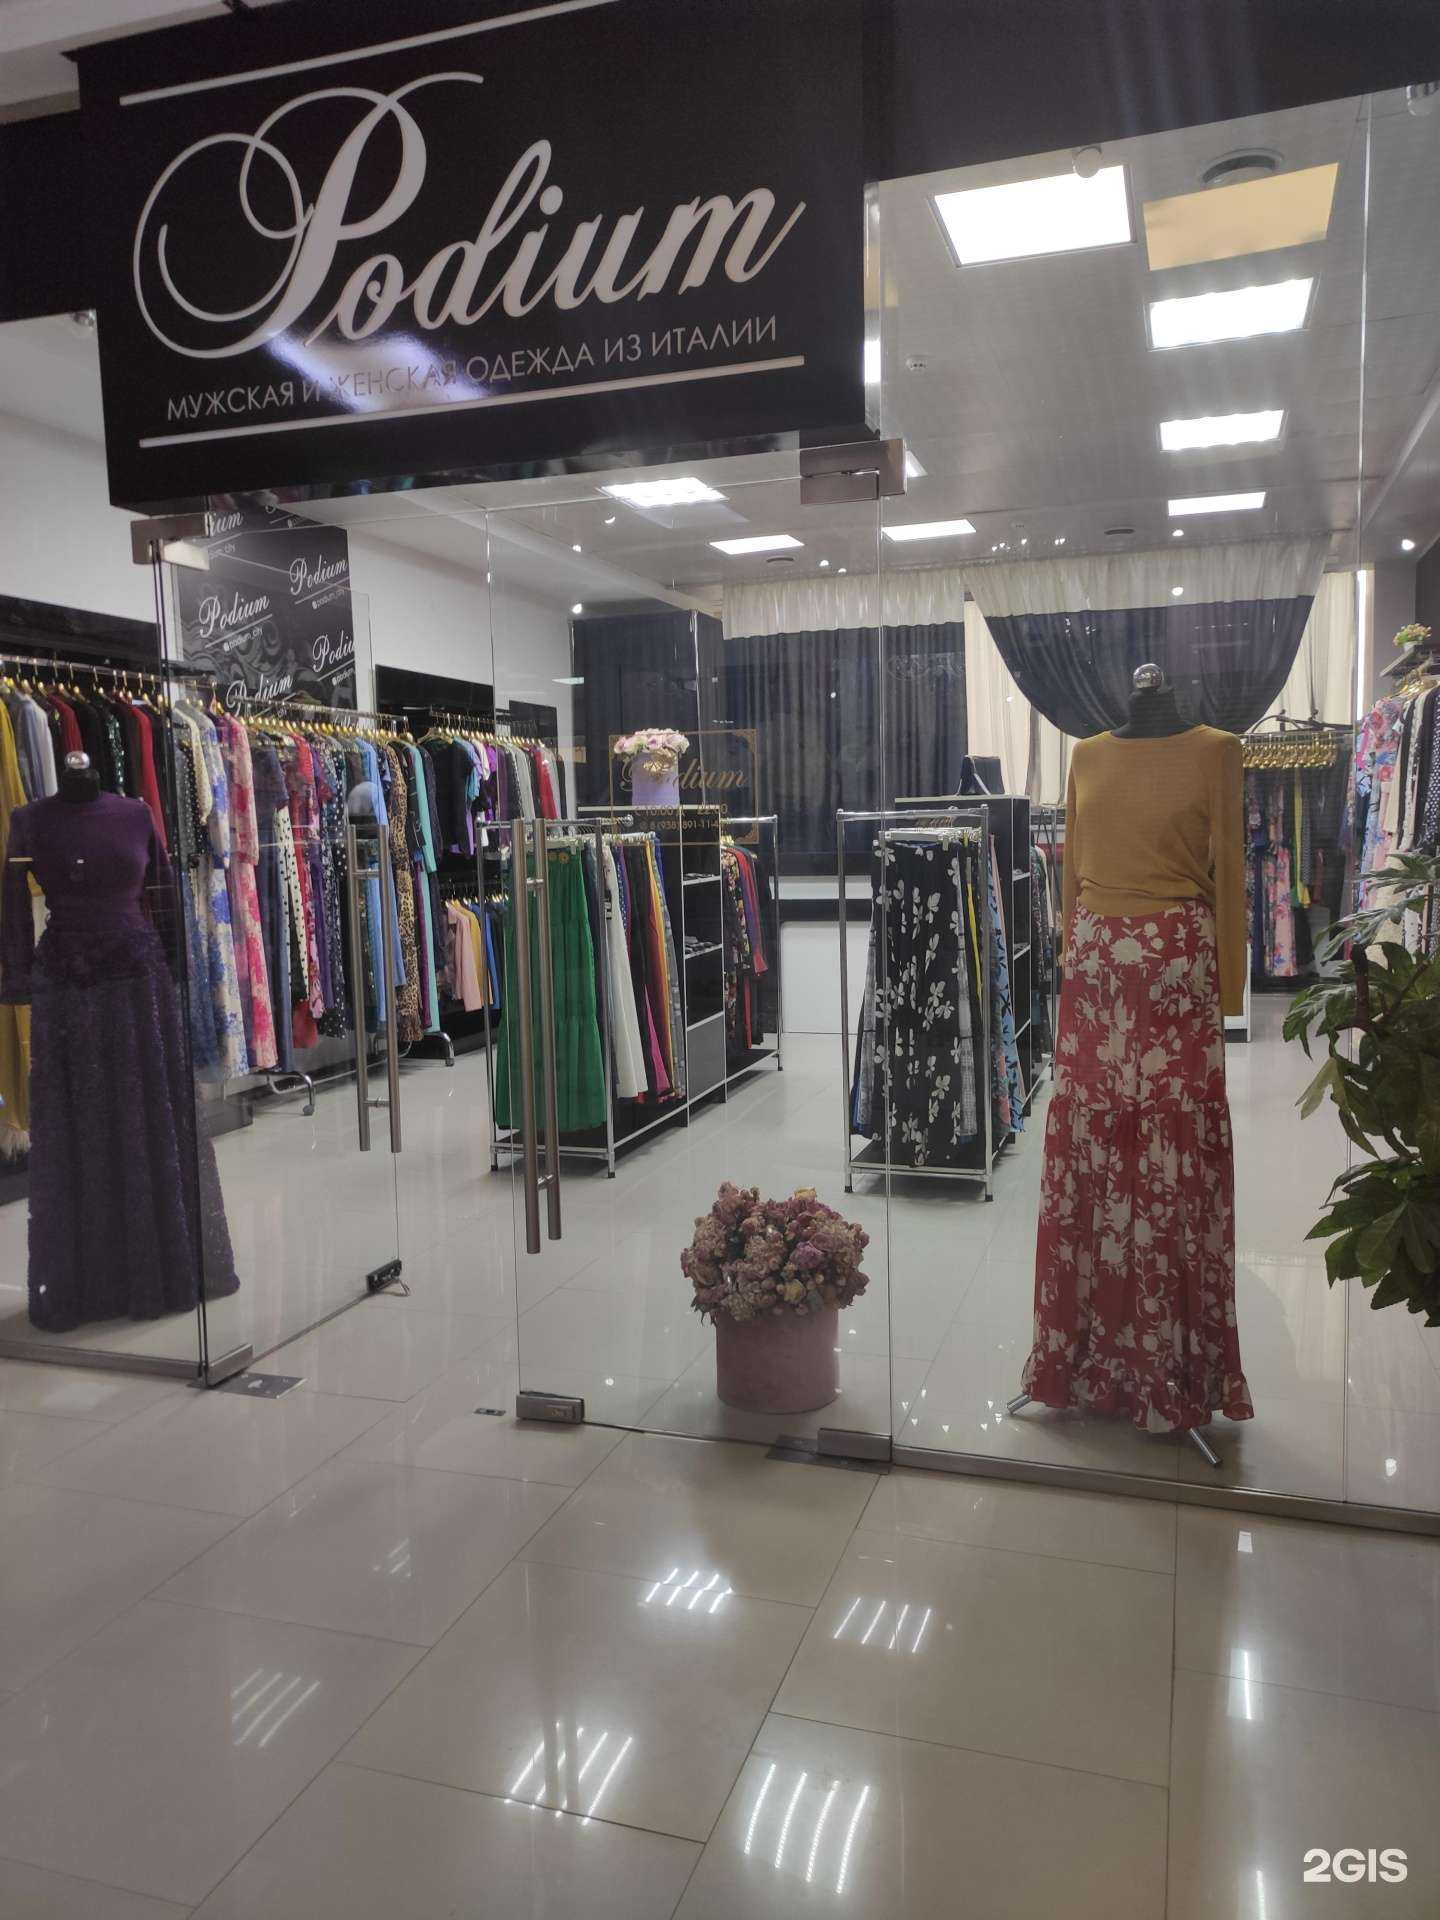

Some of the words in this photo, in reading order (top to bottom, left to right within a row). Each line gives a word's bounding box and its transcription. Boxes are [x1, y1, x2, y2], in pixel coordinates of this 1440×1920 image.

[133, 71, 806, 359] Podium
[167, 381, 294, 421] МУЖСКАЯ
[303, 379, 320, 403] И
[328, 357, 457, 401] ЖЕНСКАЯ
[466, 343, 595, 384] ОДЕЖДА
[604, 333, 642, 363] ИЗ
[652, 314, 777, 357] ИТАЛИИ
[289, 554, 348, 596] Podium
[199, 592, 270, 638] Podium
[312, 630, 355, 673] Podiu
[226, 673, 294, 717] Pdium
